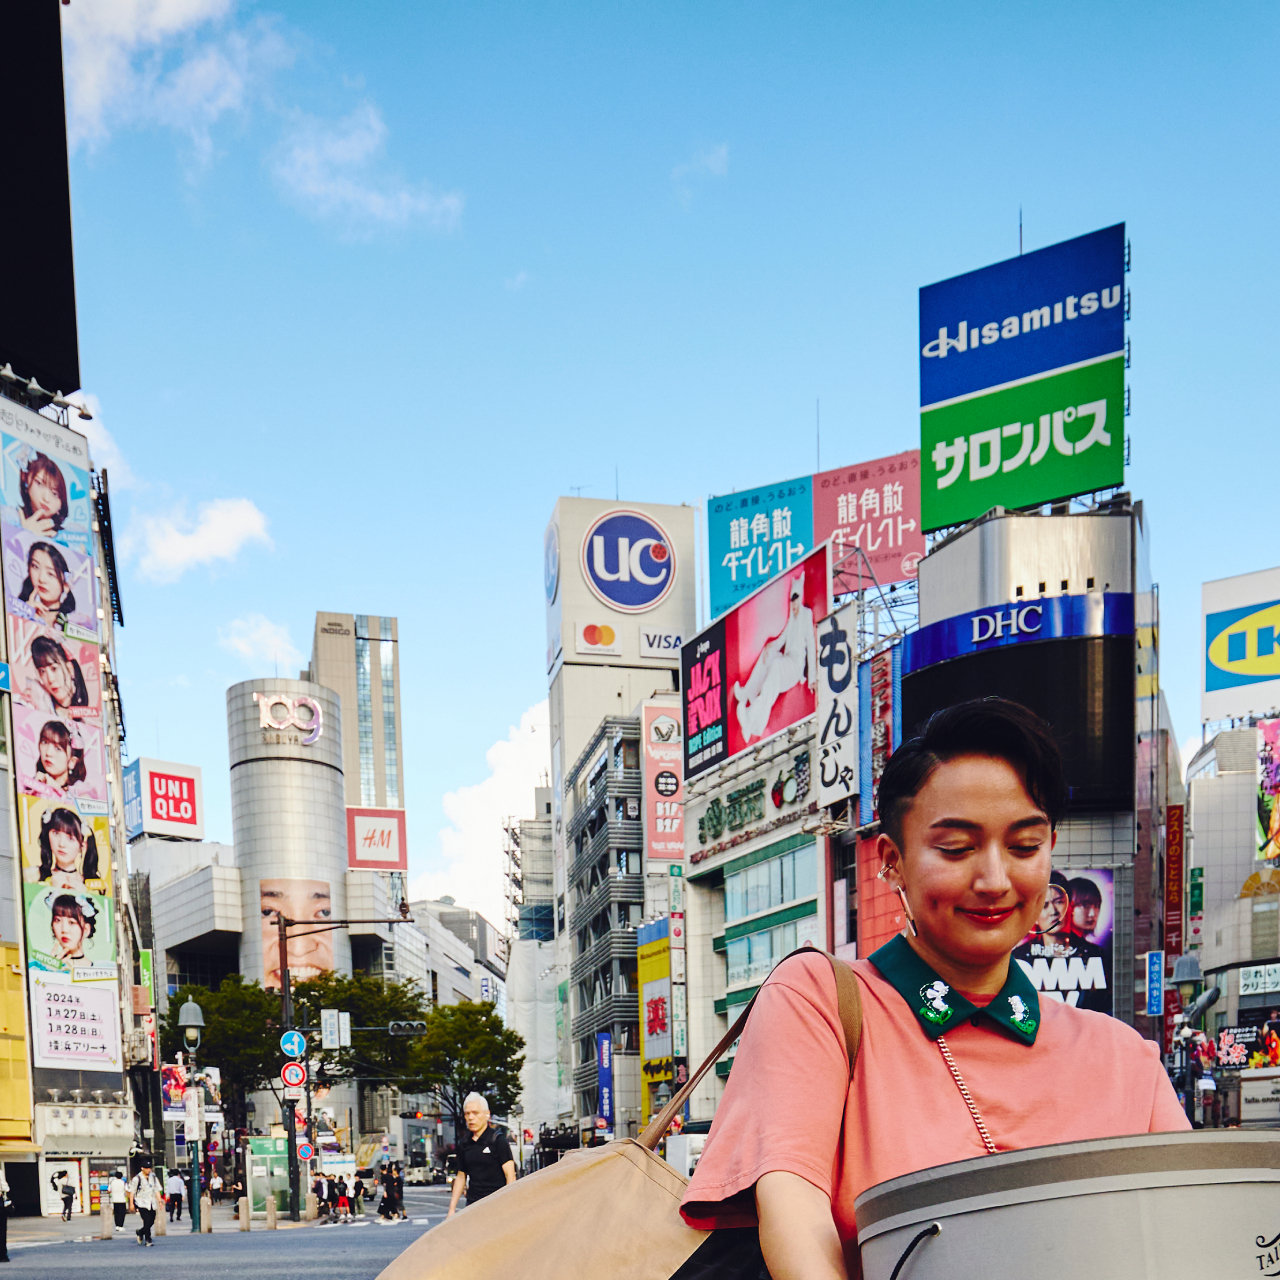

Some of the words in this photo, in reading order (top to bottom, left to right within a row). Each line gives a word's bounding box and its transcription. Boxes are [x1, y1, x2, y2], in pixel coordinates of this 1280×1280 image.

[921, 283, 1121, 360] Hisamitsu
[931, 397, 1112, 491] サロンパス
[837, 480, 904, 526] 龍角散
[729, 506, 793, 549] 龍角散
[829, 515, 917, 558] ダイレクト
[721, 539, 805, 582] ダイレクト
[643, 632, 682, 650] VISA
[970, 604, 1044, 644] DHC
[252, 691, 324, 747] 109
[819, 615, 854, 793] もんじゃ
[153, 777, 189, 800] UNI
[154, 797, 193, 819] QLO
[361, 828, 393, 851] H&M
[602, 1039, 610, 1069] MIZUNO
